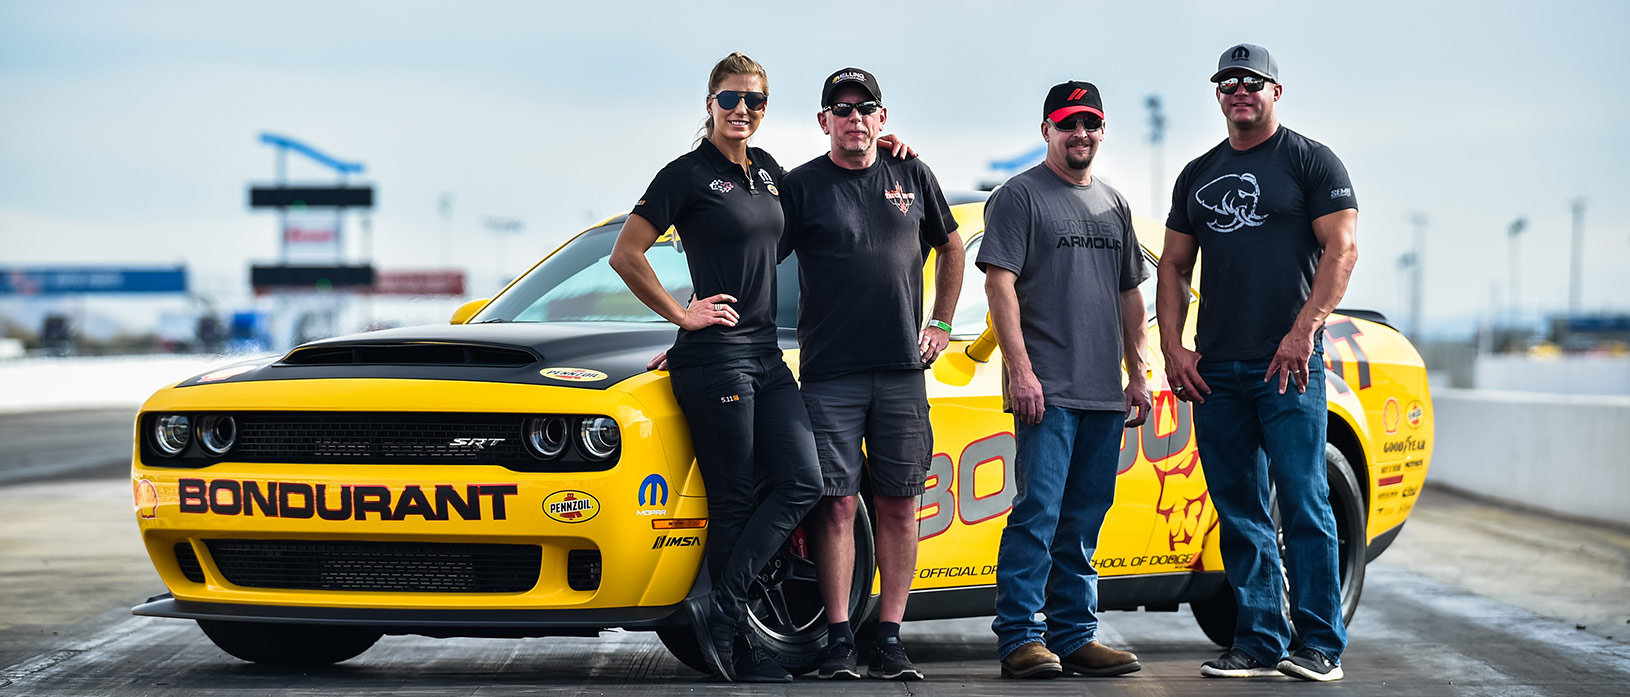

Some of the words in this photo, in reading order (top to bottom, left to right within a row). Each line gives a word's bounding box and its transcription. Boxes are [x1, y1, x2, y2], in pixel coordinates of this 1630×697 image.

[1056, 236, 1121, 250] ARMOUR
[449, 438, 506, 449] SRT
[178, 478, 518, 521] BONDURANT
[550, 499, 591, 513] PENNZOIL
[664, 536, 701, 547] IMSA
[919, 566, 977, 579] OFFICIAL
[1130, 556, 1148, 566] OF
[1149, 553, 1194, 565] DODGE
